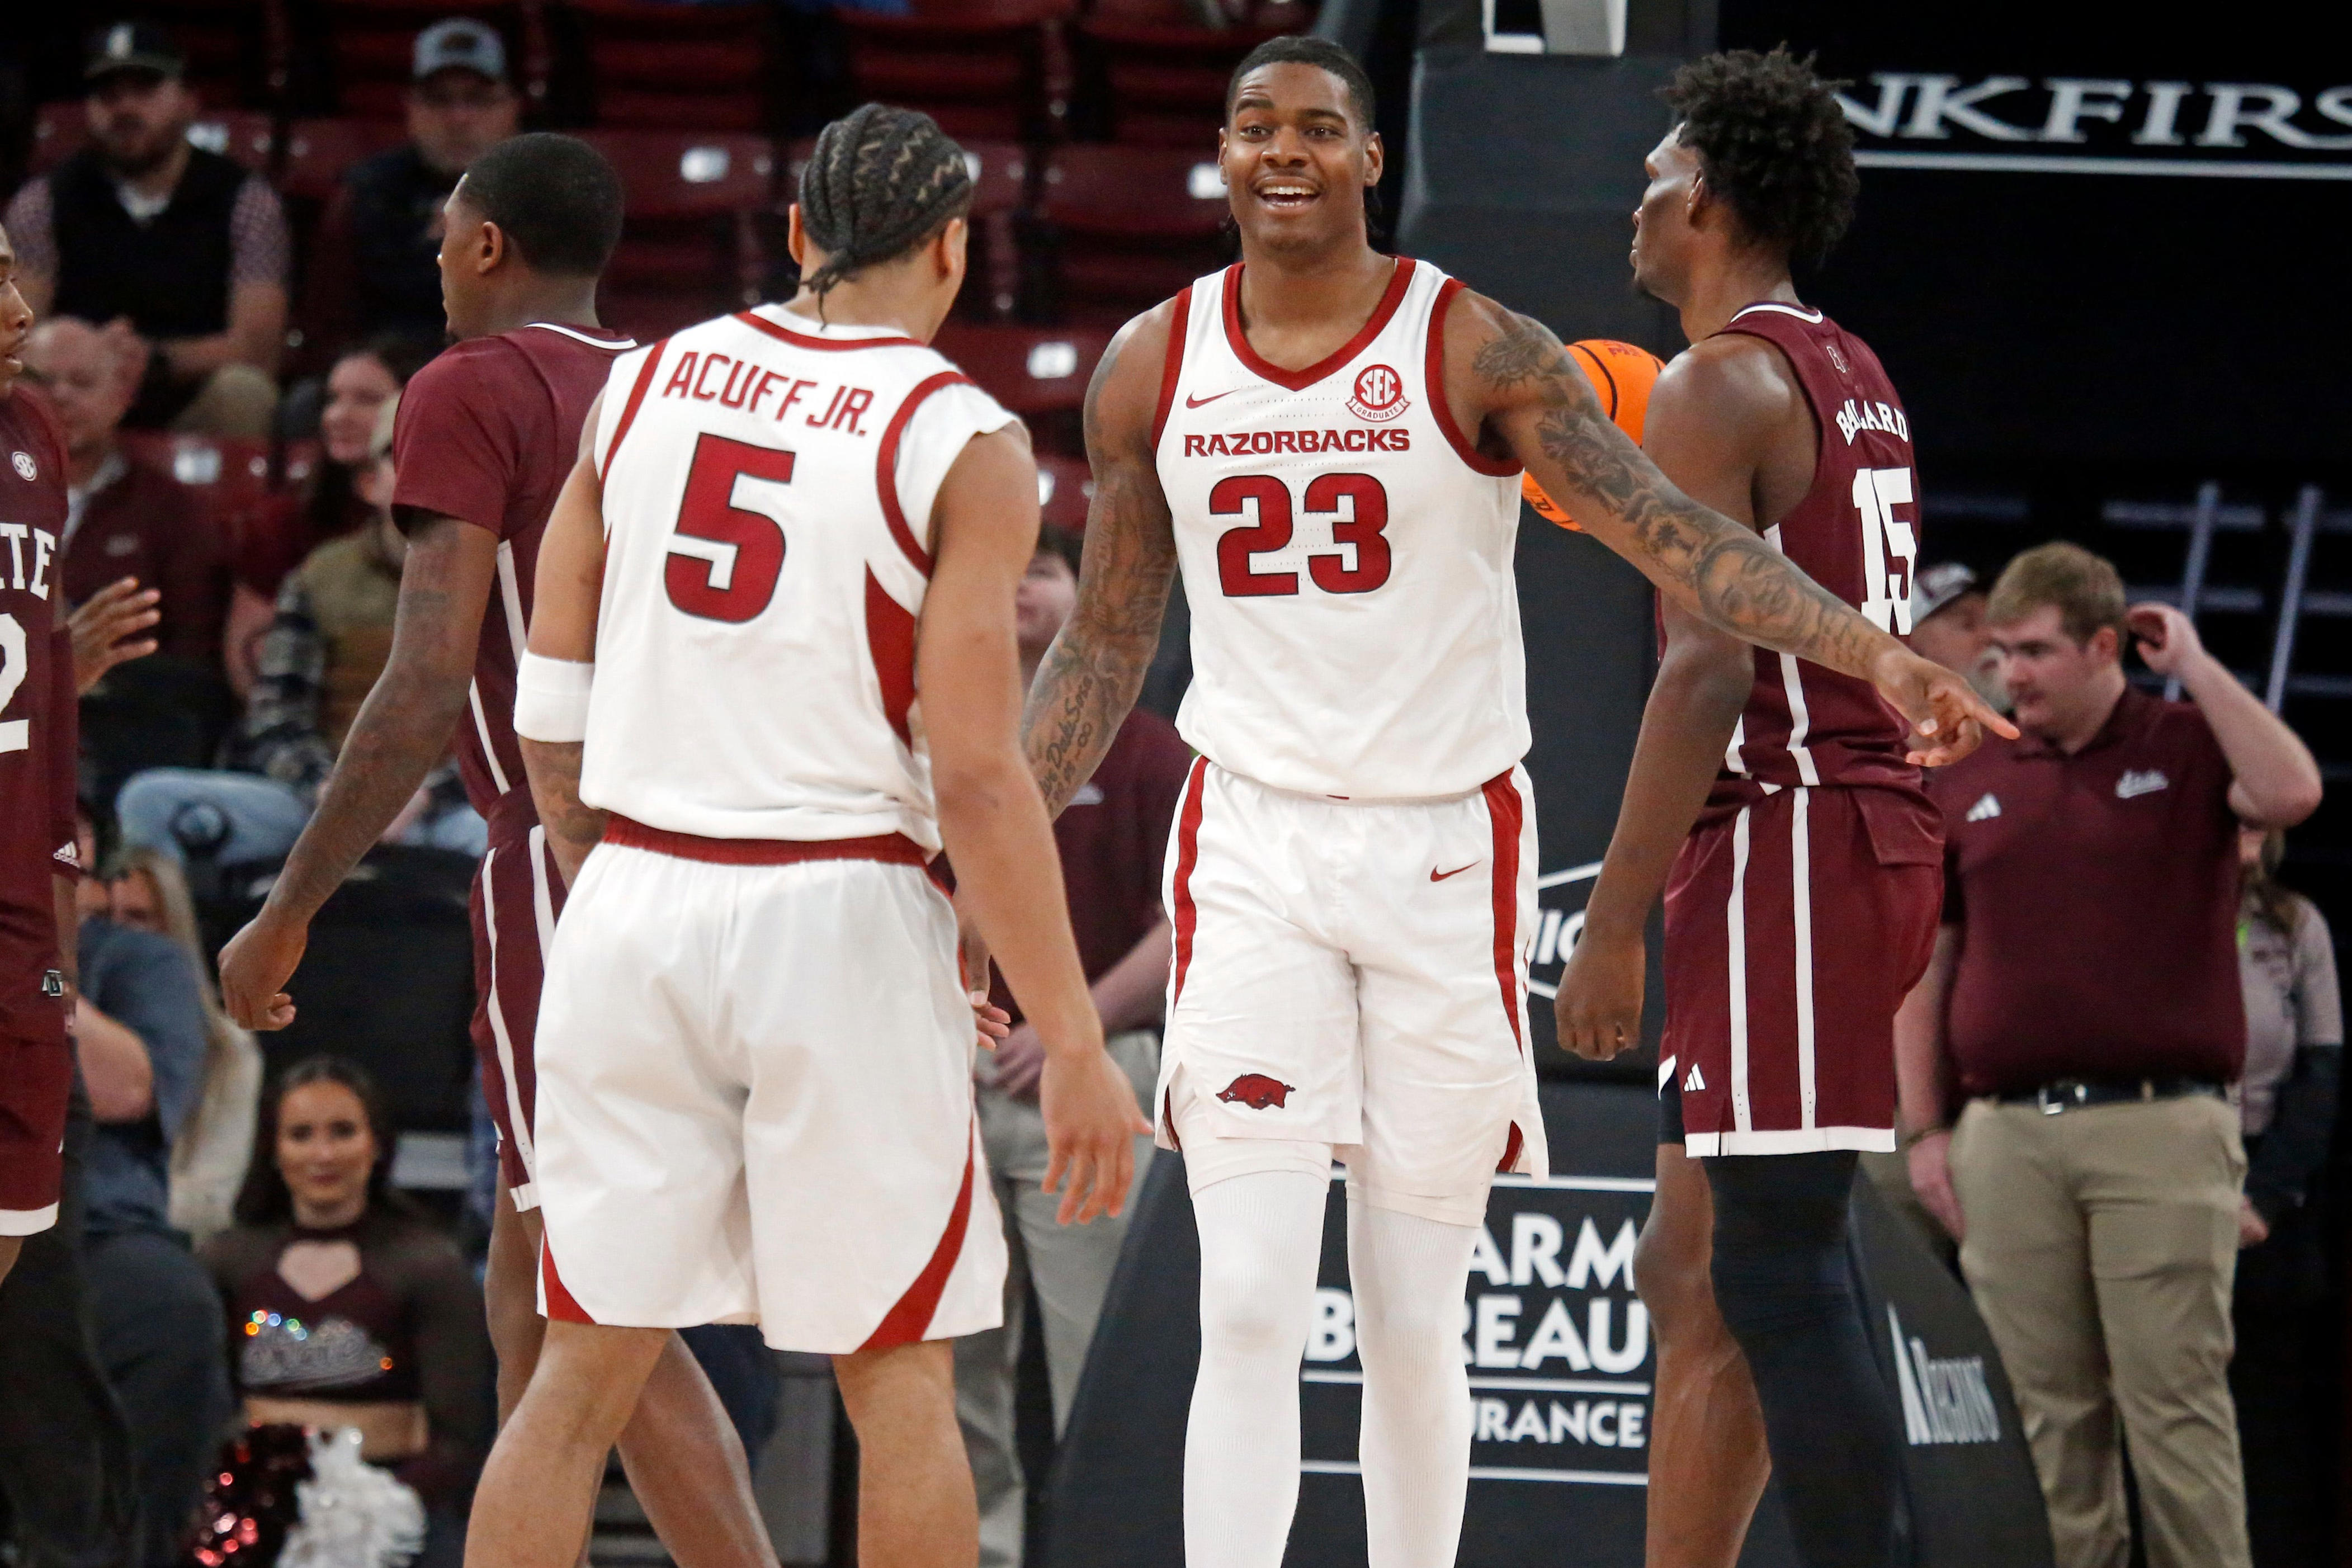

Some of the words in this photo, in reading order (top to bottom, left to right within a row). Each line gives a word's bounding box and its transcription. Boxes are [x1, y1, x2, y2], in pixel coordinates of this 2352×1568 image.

[662, 351, 818, 422] ACUFF
[805, 385, 875, 437] JR.
[1357, 405, 1399, 419] GRADUATE
[1360, 369, 1396, 405] SEC
[1184, 428, 1410, 457] RAZORBACKS
[0, 522, 56, 601] TE
[664, 432, 796, 624] 5
[1209, 473, 1391, 597] 23
[1852, 467, 1918, 635] 15
[1303, 1287, 1650, 1374] BEAU
